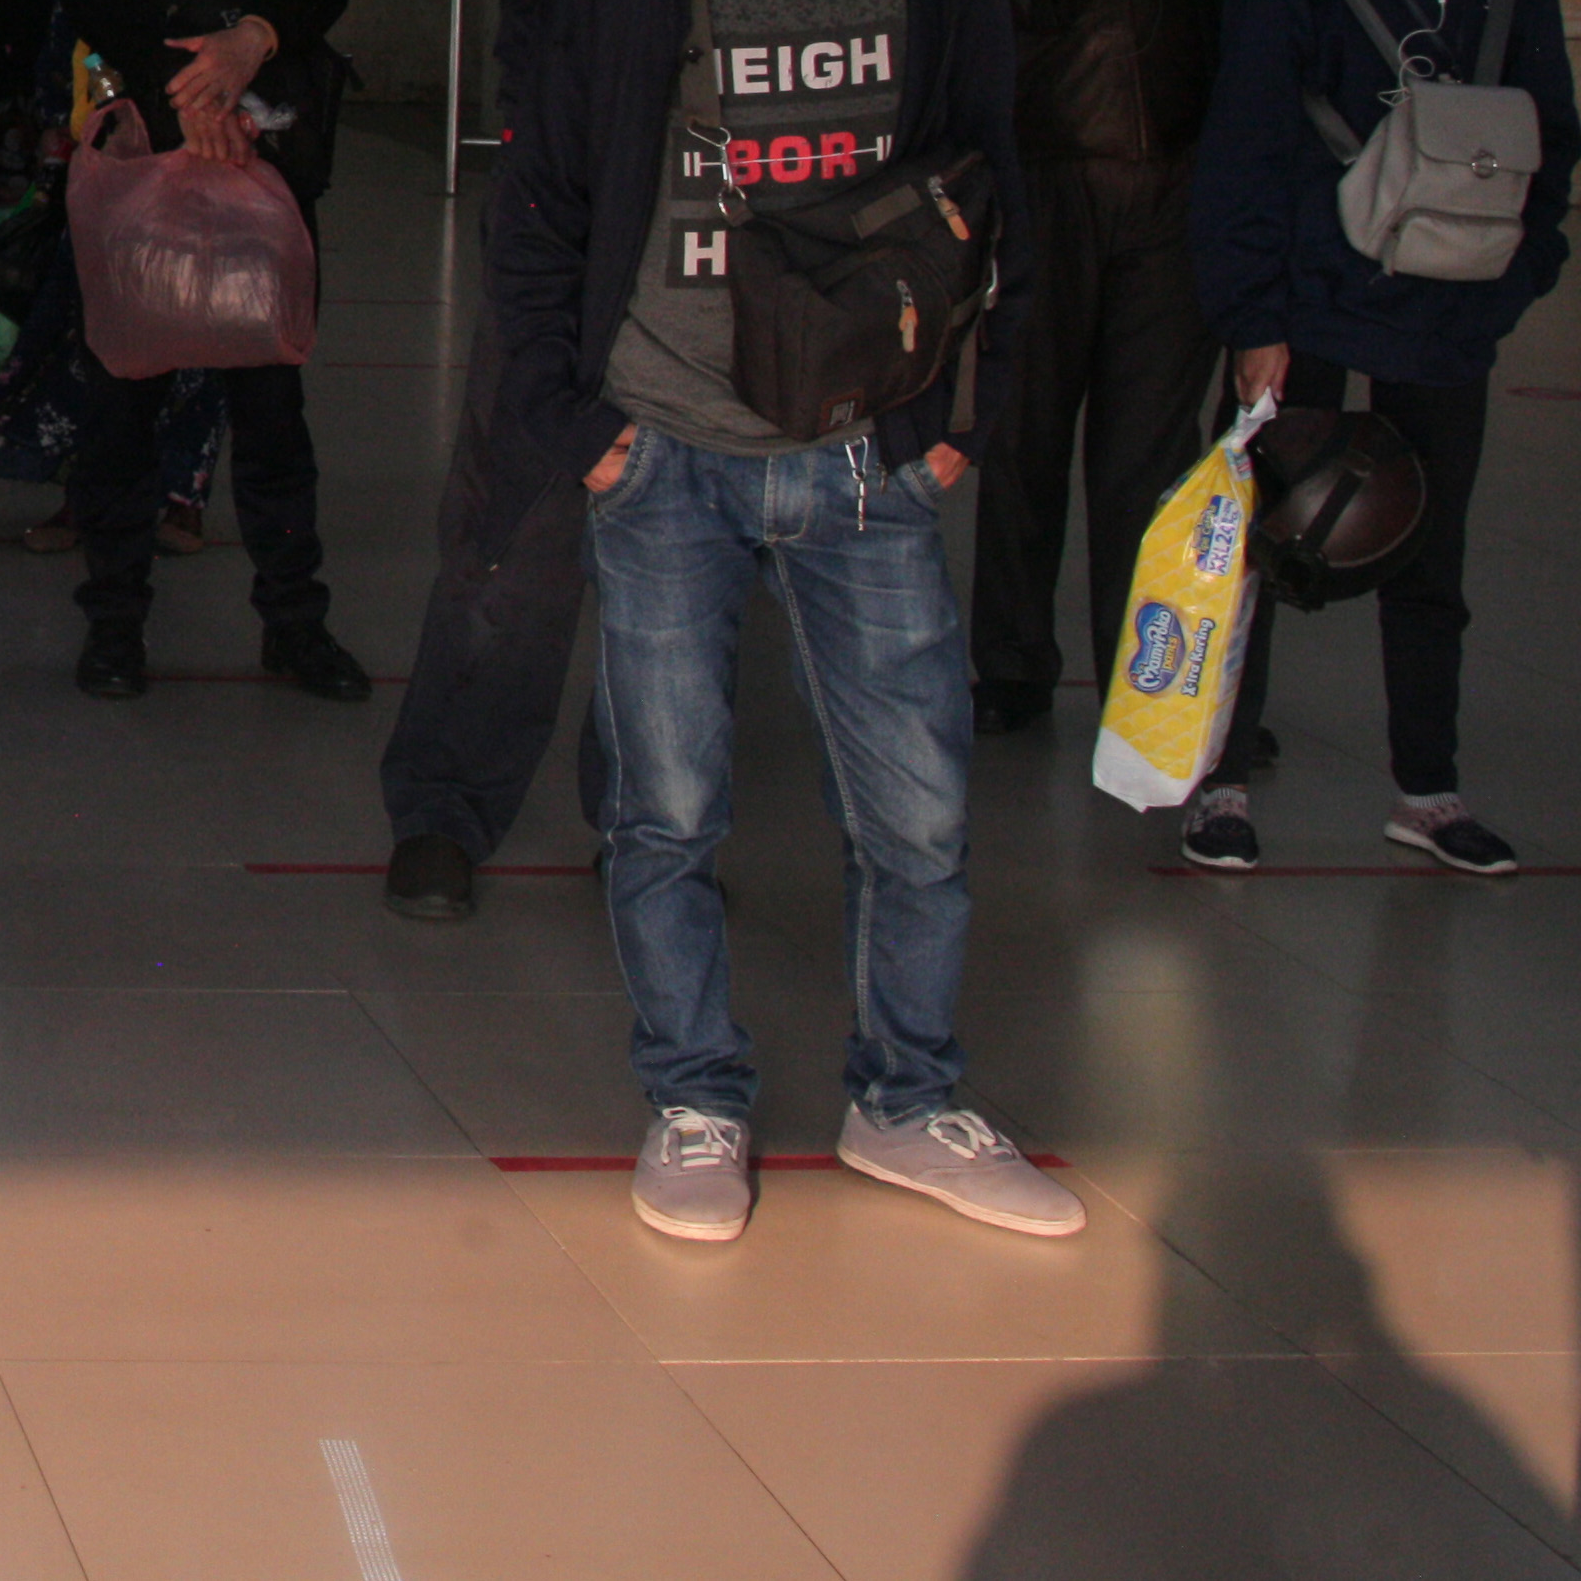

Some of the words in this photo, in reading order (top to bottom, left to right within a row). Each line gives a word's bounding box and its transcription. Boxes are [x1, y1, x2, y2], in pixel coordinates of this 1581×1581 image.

[726, 130, 859, 186] BOR
[1137, 609, 1173, 688] MamyPoko
[1189, 617, 1216, 662] Kering
